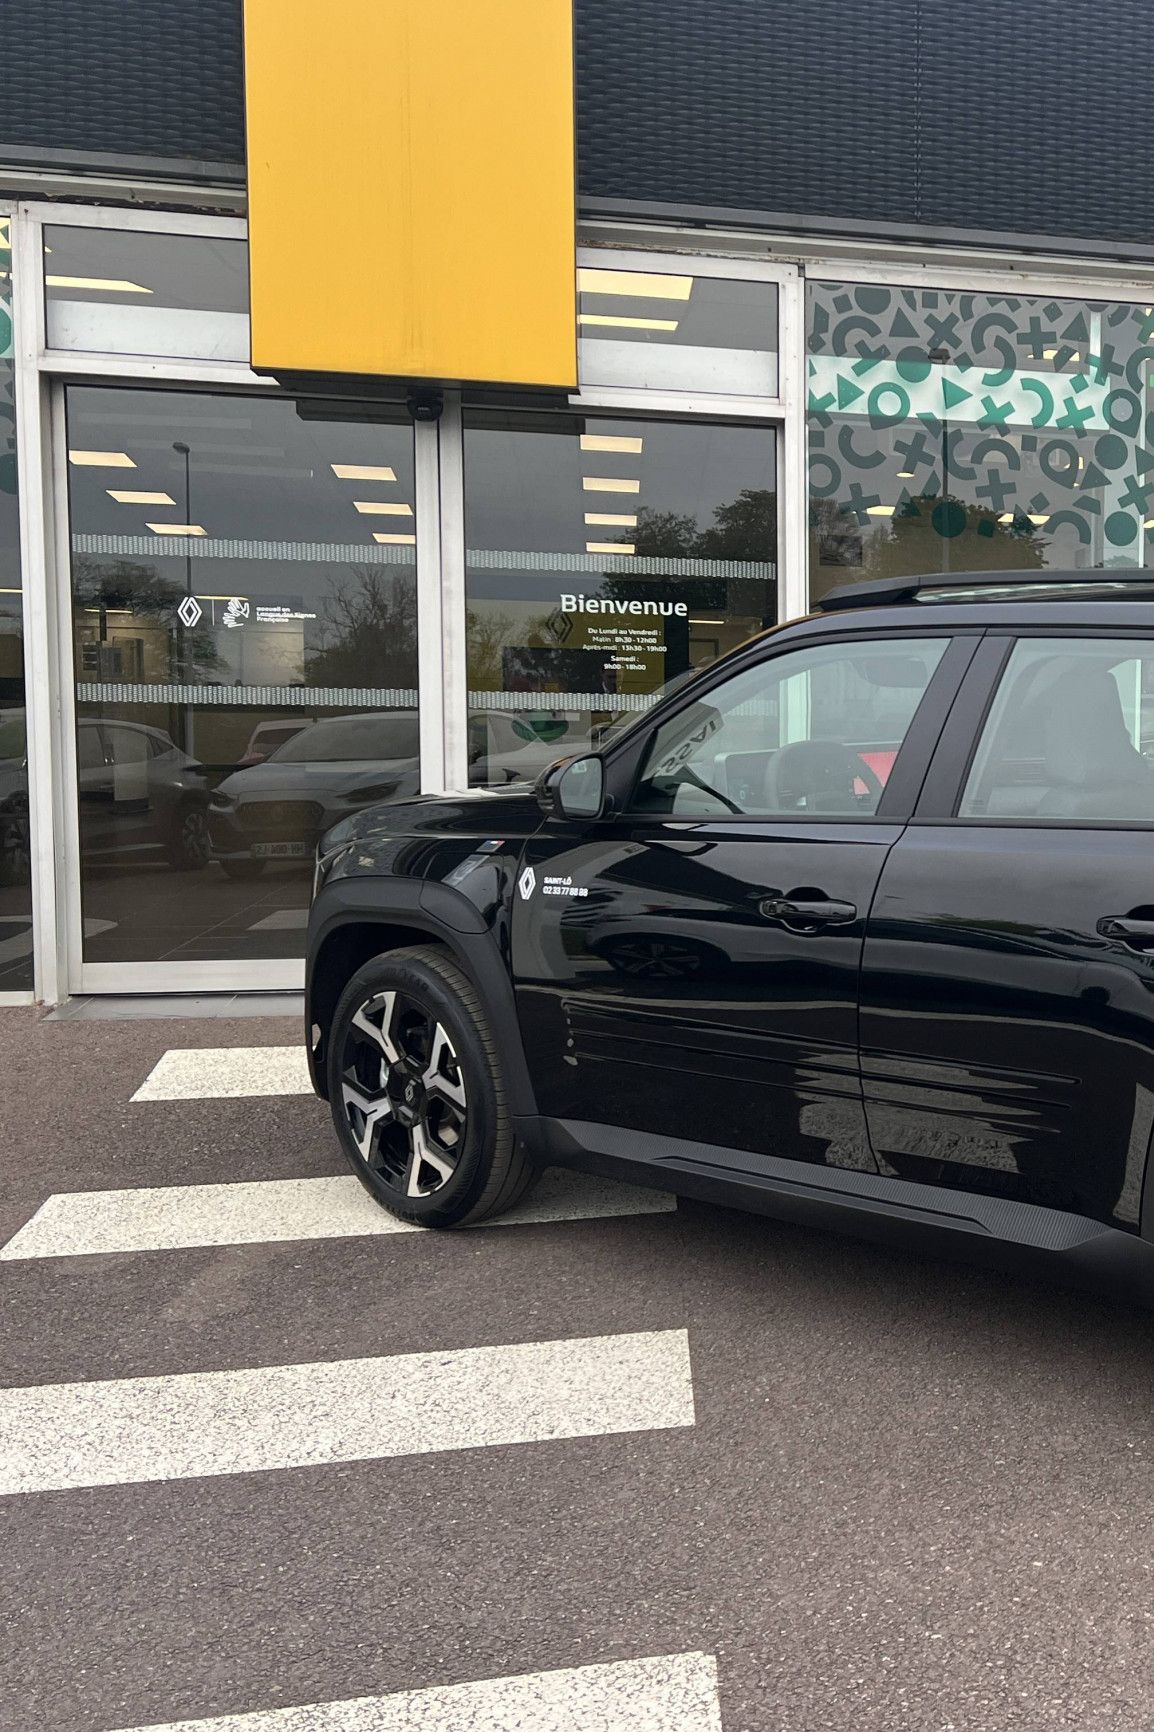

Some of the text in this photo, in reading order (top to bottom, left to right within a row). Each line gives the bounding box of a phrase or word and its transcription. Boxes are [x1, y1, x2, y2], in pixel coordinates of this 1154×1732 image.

[560, 594, 688, 616] Bienvenue
[628, 628, 658, 636] Vendredi
[543, 876, 572, 885] SAINT-LÔ
[542, 886, 551, 895] 02
[552, 886, 561, 895] 33
[561, 886, 570, 895] 77
